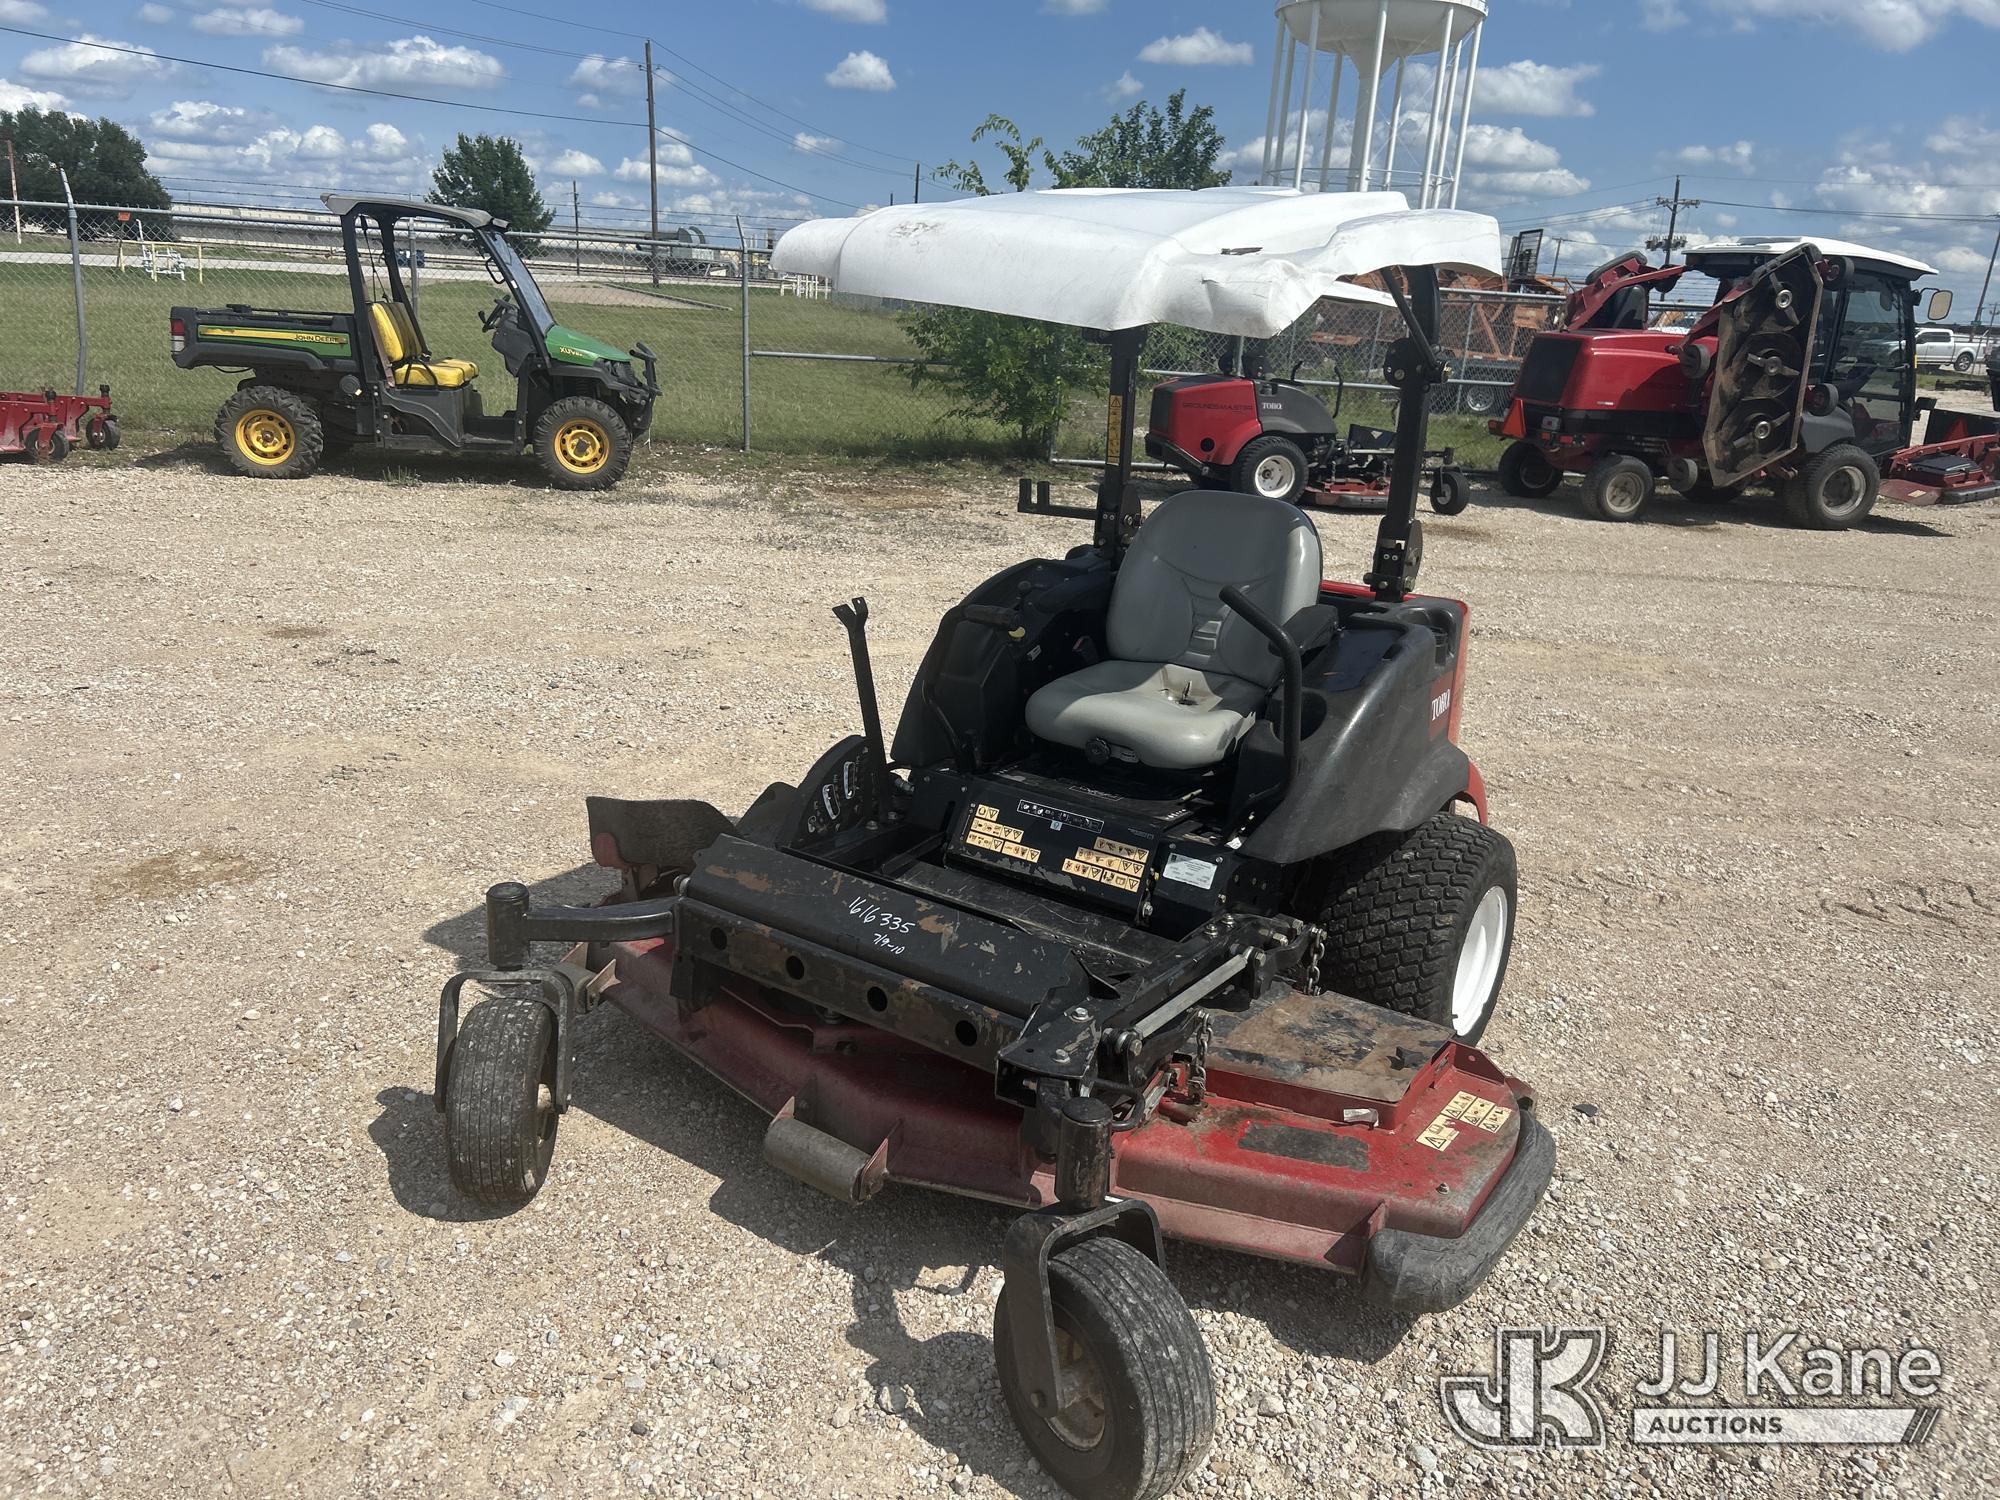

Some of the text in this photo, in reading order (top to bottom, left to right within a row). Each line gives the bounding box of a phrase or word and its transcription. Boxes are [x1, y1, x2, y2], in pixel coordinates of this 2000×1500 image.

[294, 334, 314, 342] JOHN
[1262, 402, 1283, 410] TORO
[1431, 688, 1451, 721] TORO
